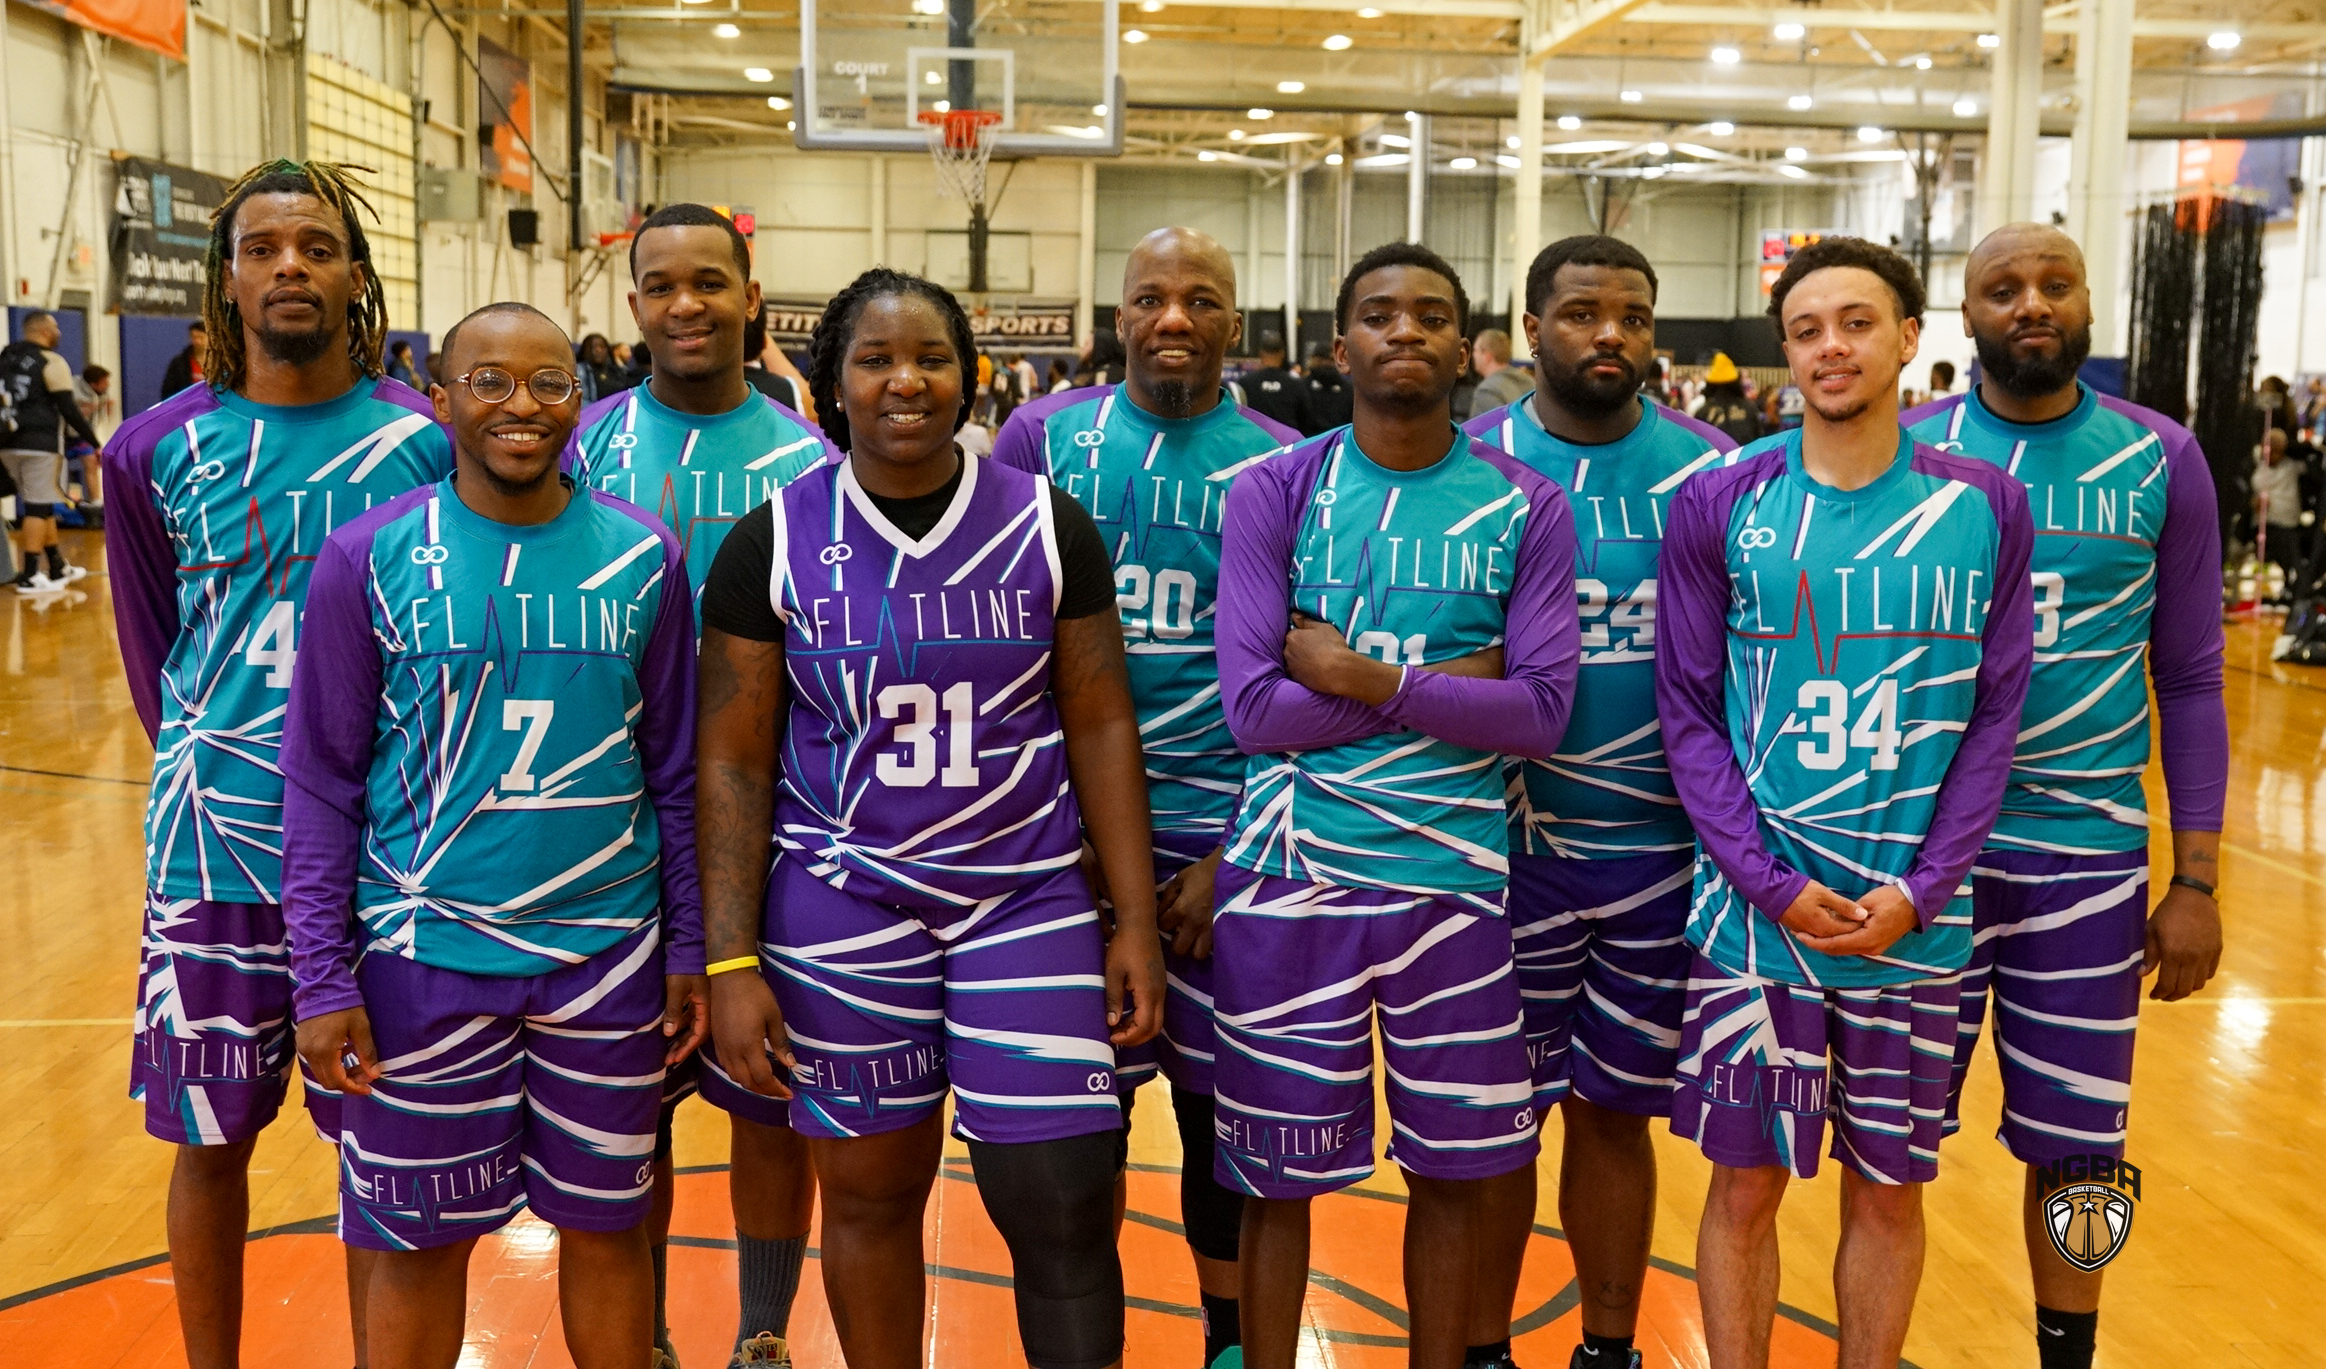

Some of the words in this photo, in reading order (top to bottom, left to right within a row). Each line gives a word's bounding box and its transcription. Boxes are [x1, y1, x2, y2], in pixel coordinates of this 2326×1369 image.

[834, 61, 889, 75] COURT
[855, 75, 868, 94] 1
[970, 315, 1070, 334] SPORTS
[2026, 484, 2144, 538] LINE
[410, 593, 640, 657] FLATLINE
[813, 589, 1034, 648] FLATLINE
[1114, 564, 1197, 640] 20
[1575, 578, 1658, 647] 24
[245, 599, 302, 688] 4
[500, 699, 555, 791] 7
[876, 681, 980, 788] 31
[1797, 679, 1902, 771] 34
[815, 1045, 939, 1090] FLATLINE
[1233, 1119, 1346, 1156] FLATLINE
[374, 1154, 505, 1205] FLATLINE
